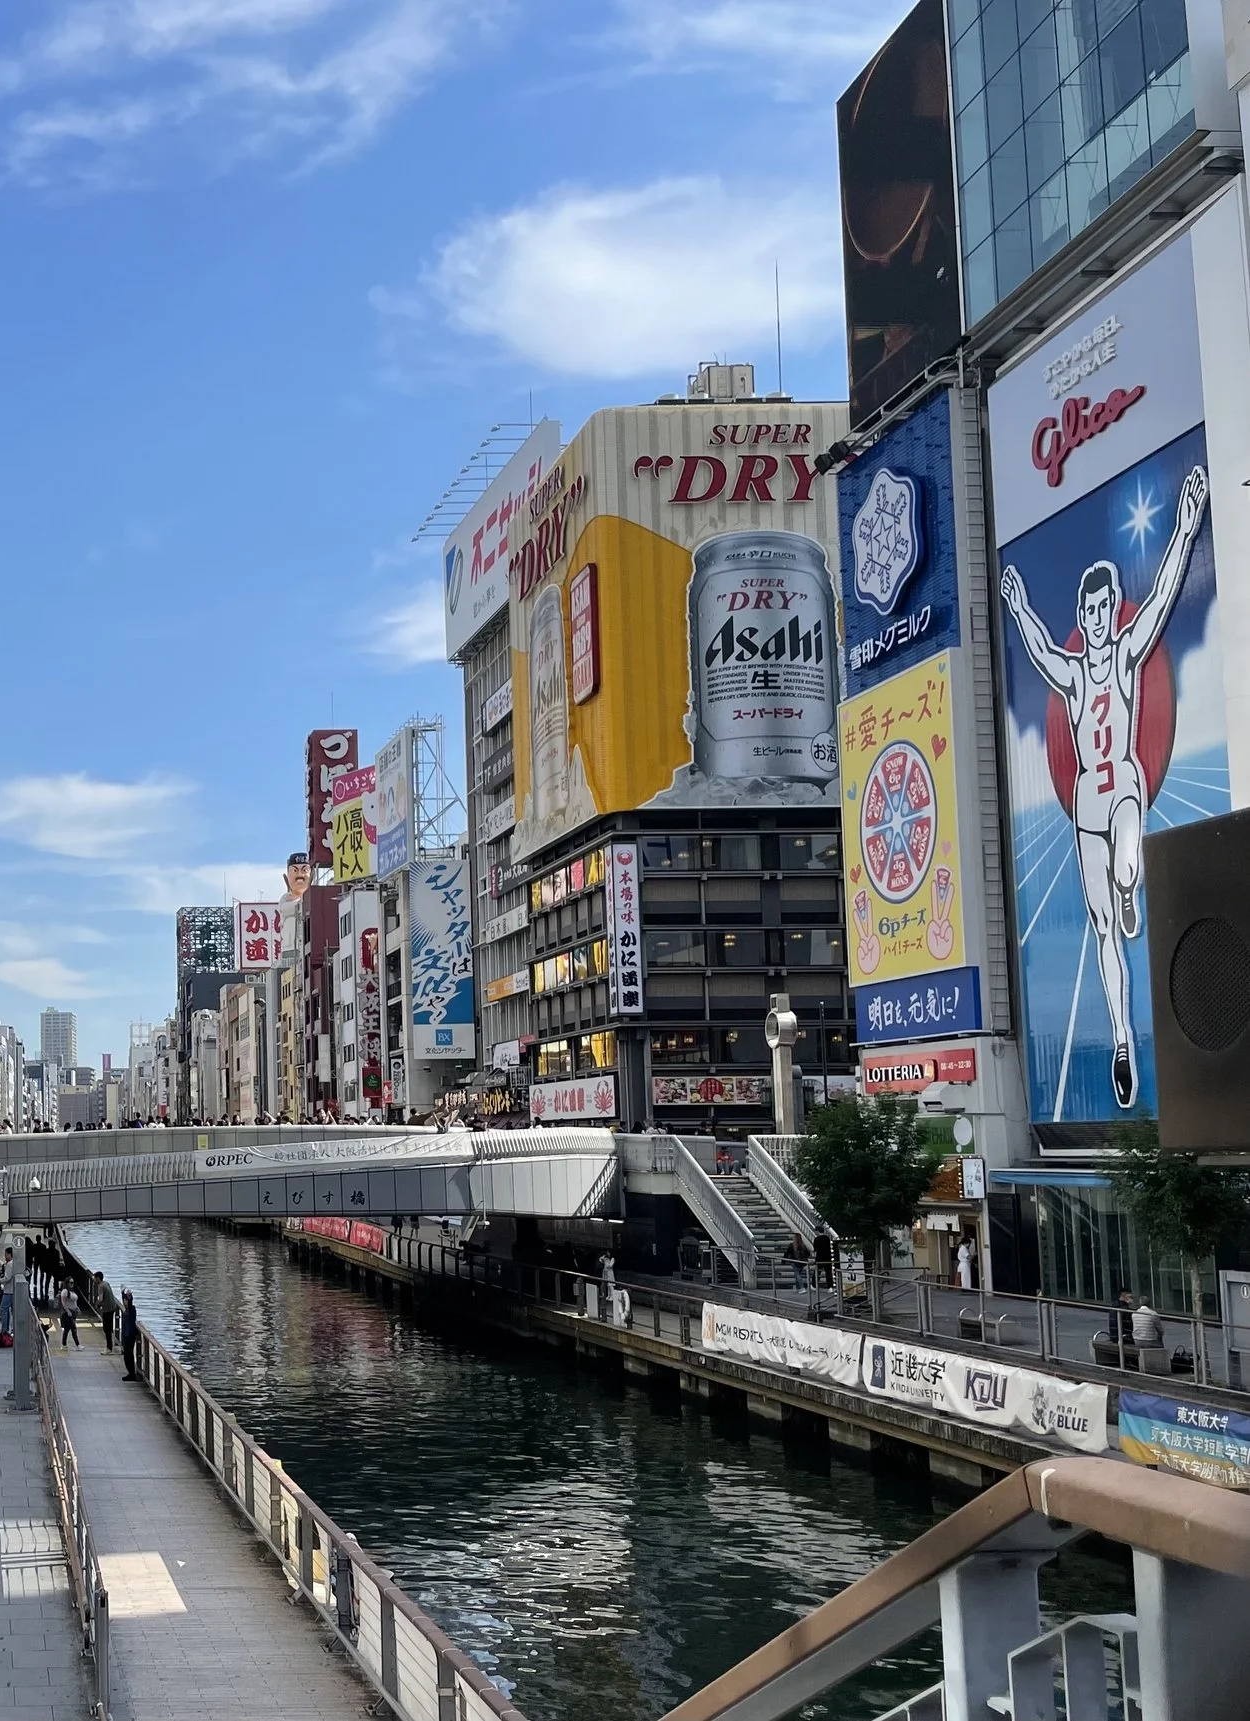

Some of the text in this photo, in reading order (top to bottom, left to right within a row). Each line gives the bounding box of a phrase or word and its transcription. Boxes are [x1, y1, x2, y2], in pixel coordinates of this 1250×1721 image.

[709, 424, 813, 445] SUPER
[1031, 385, 1145, 487] Glico
[529, 465, 563, 524] SUPER
[725, 553, 746, 561] KARA
[772, 552, 797, 560] KUCHI
[740, 578, 784, 588] SUPER
[572, 620, 592, 664] 1889
[705, 615, 823, 668] Asahi
[850, 604, 931, 671] 雪印メグミルク
[751, 670, 781, 690] 生
[732, 707, 804, 720] スーパードライ
[1090, 684, 1115, 795] グリコ
[752, 746, 785, 757] 生ビール
[885, 755, 904, 772] SNOW
[336, 811, 350, 878] バイト
[350, 807, 363, 875] 高収入
[618, 869, 635, 925] 本場の味
[425, 864, 472, 977] シャッターは
[620, 930, 640, 1008] かに道楽
[437, 1032, 451, 1041] BX
[424, 1047, 467, 1055] 文化シャッター
[866, 1064, 922, 1083] LOTTERIA
[262, 1190, 366, 1206] えびす橋
[890, 1350, 946, 1386] 近畿大学
[1057, 1415, 1088, 1433] BLUE
